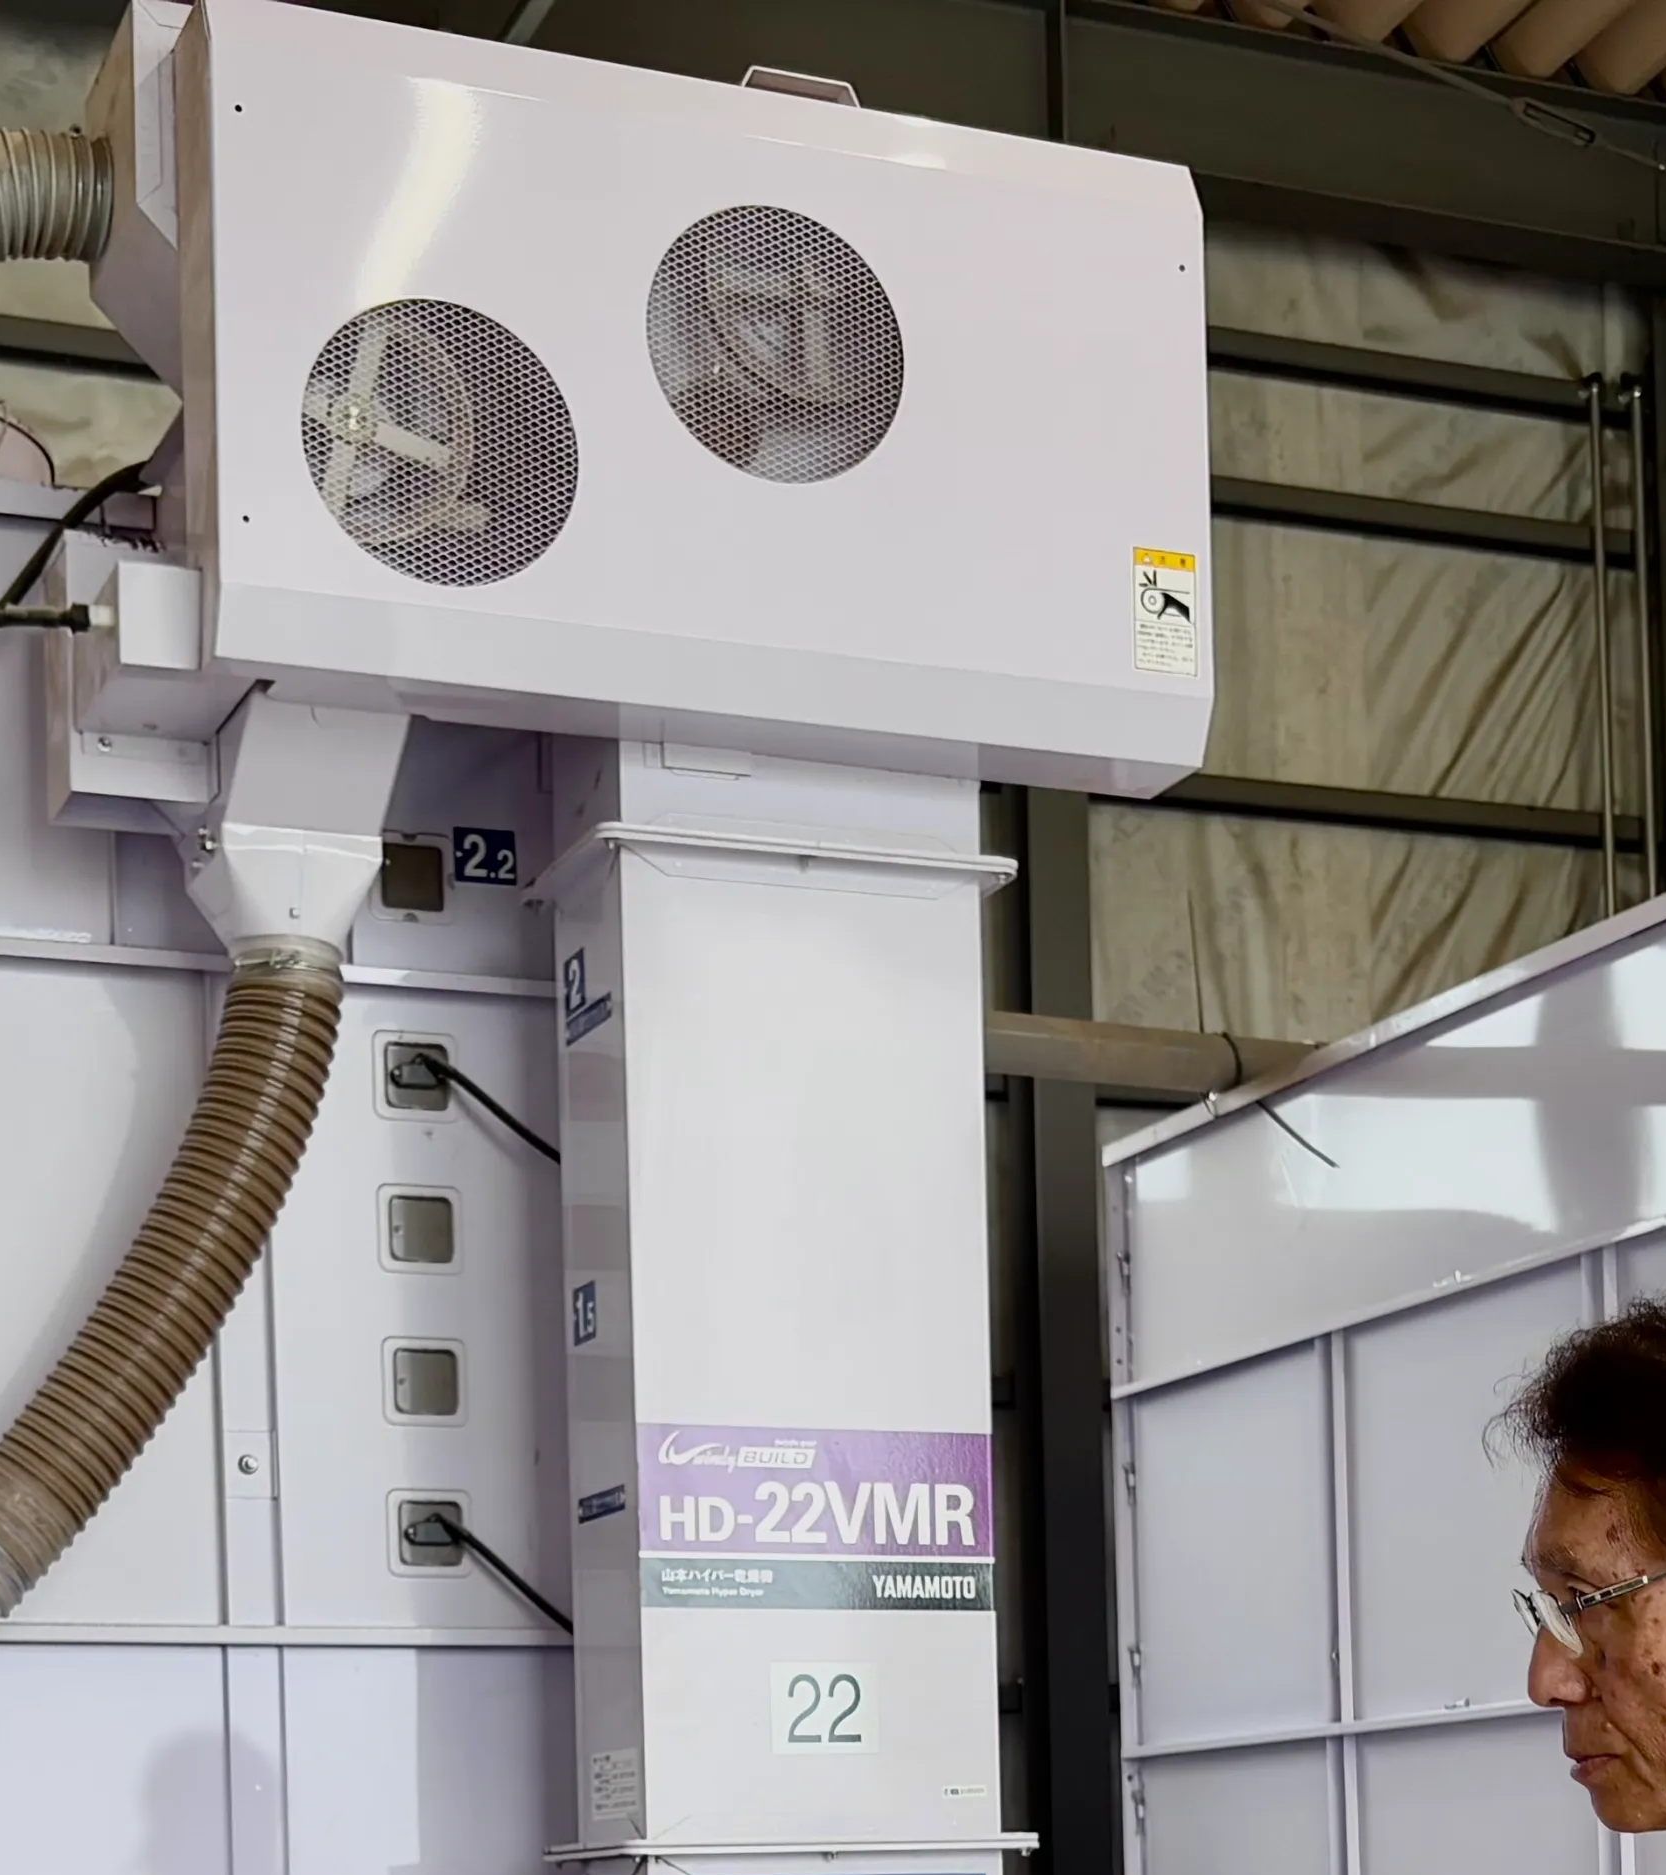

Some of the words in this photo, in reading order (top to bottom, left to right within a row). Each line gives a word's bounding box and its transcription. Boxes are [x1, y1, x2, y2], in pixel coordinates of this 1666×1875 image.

[462, 833, 516, 881] 2.2
[568, 958, 583, 1010] 2
[742, 1450, 809, 1466] BUILD
[659, 1480, 976, 1547] HD-22VMR
[872, 1574, 977, 1600] YAMAMOTO
[786, 1673, 863, 1744] 22
